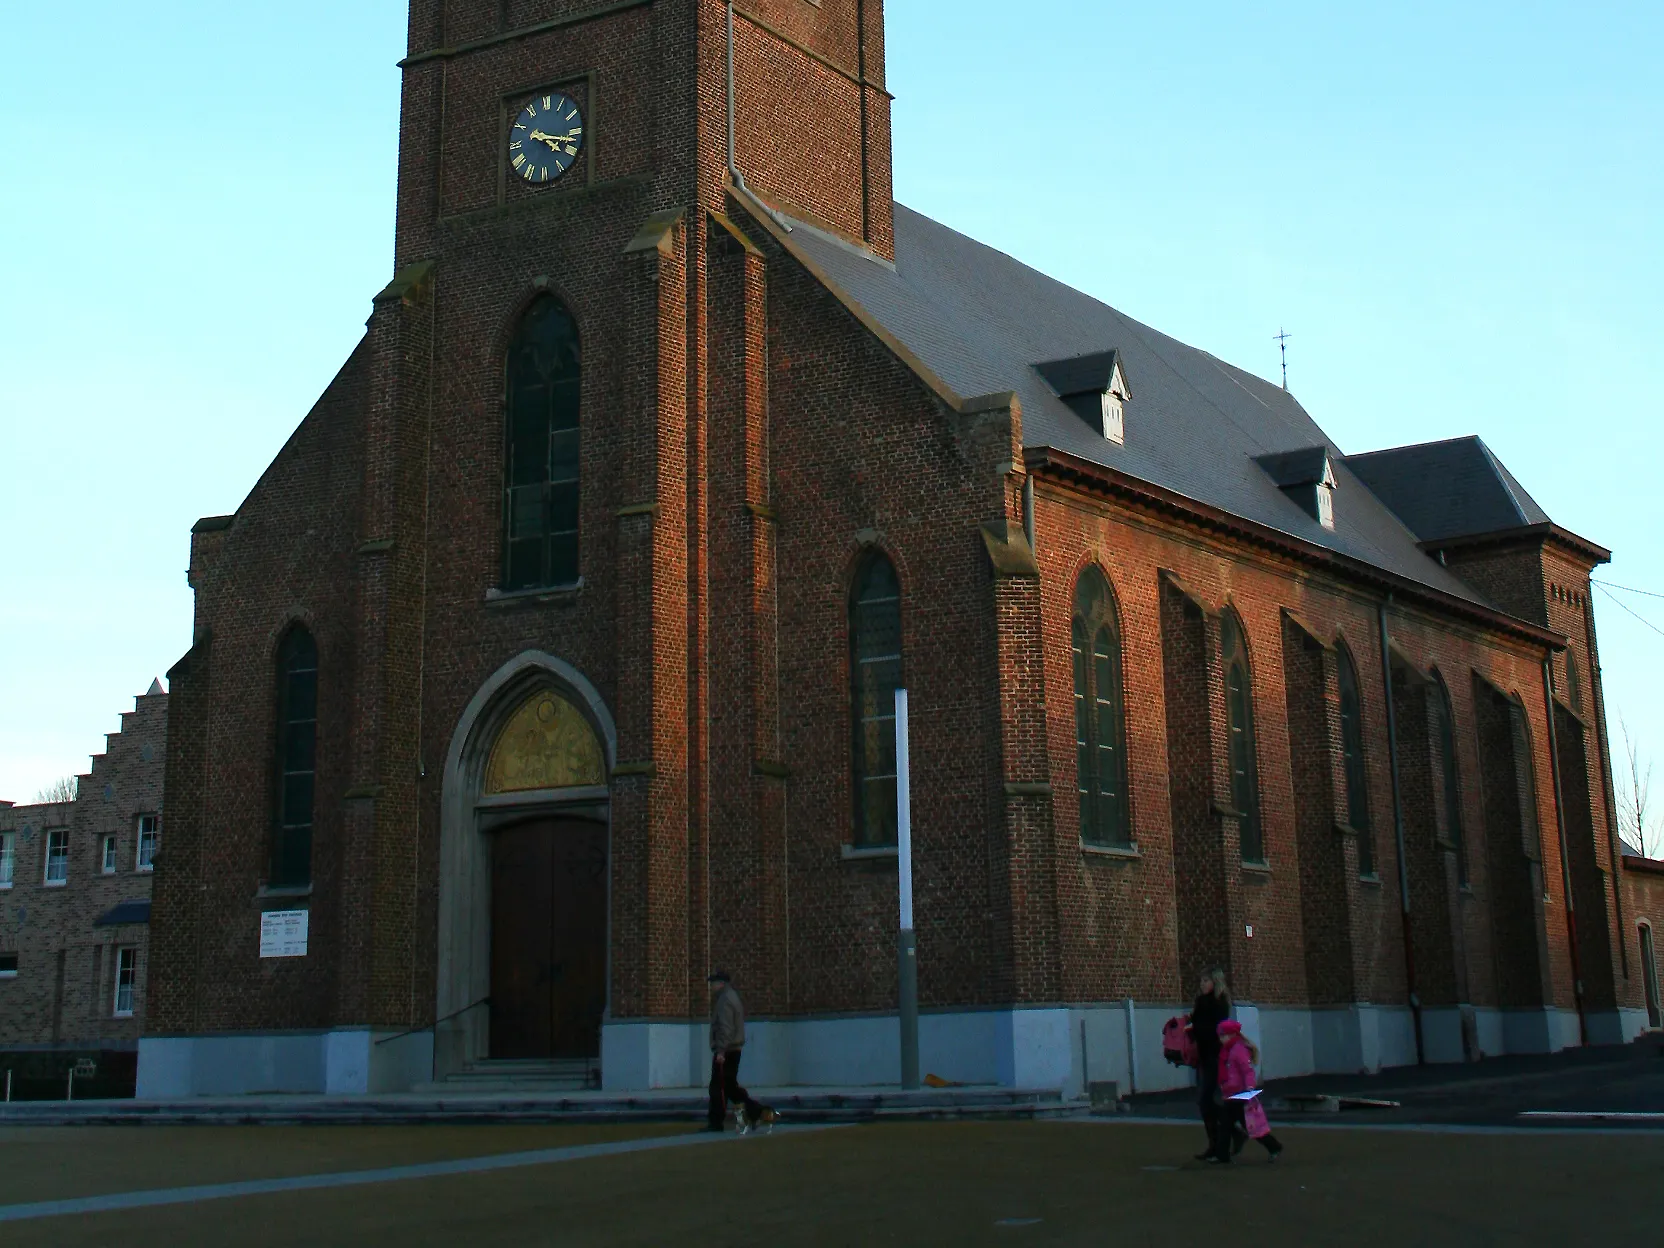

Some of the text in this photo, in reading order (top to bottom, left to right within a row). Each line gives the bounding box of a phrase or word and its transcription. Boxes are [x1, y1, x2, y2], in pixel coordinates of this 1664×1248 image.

[542, 95, 551, 111] XII
[556, 97, 565, 112] I
[526, 104, 537, 119] XI
[565, 108, 578, 122] II
[514, 121, 527, 131] X
[568, 127, 582, 136] III
[509, 140, 523, 150] IX
[511, 152, 527, 171] VIII
[555, 159, 565, 173] V
[523, 163, 535, 181] VII
[541, 166, 548, 182] VI
